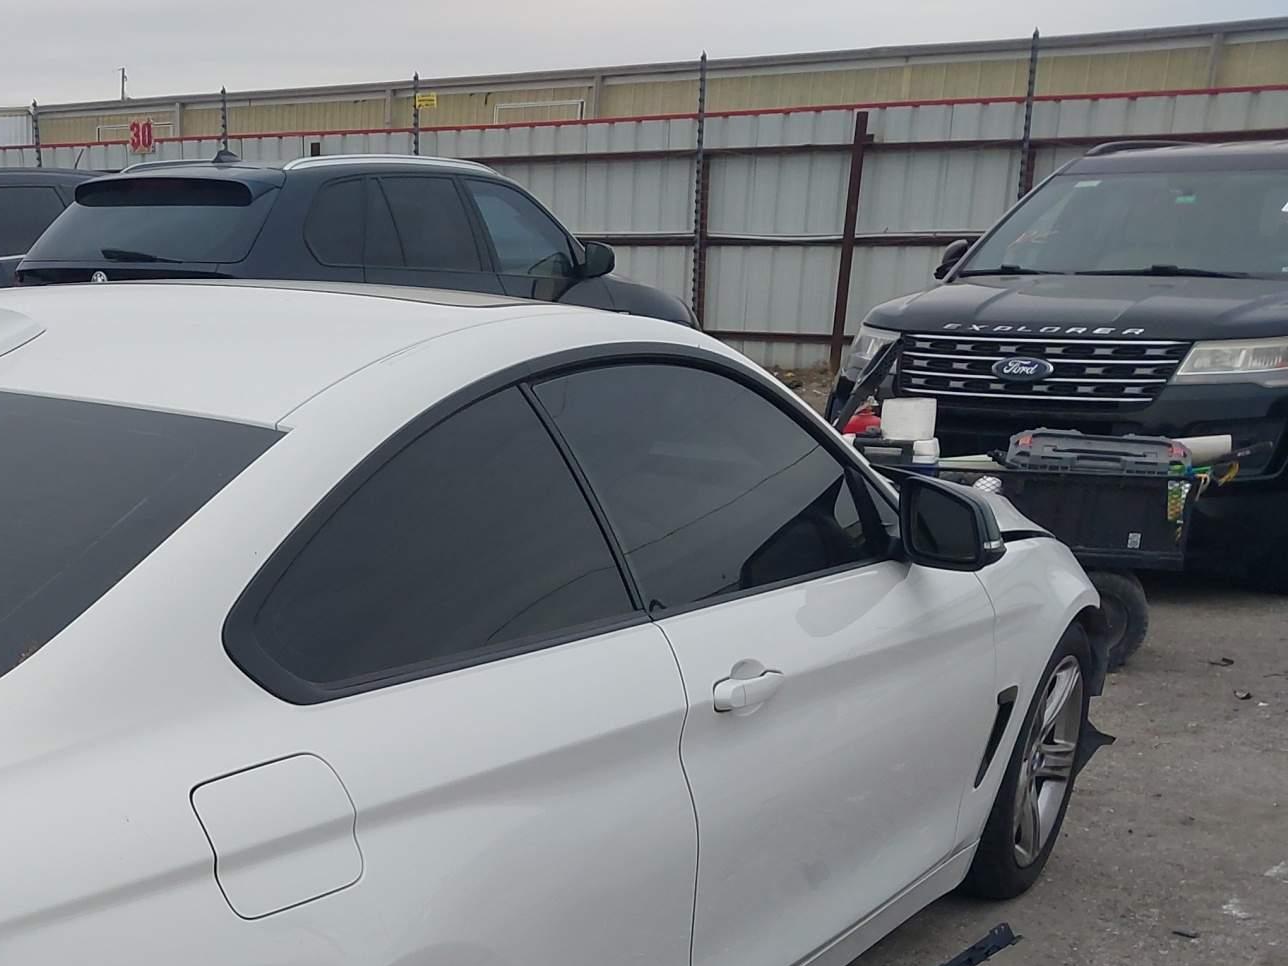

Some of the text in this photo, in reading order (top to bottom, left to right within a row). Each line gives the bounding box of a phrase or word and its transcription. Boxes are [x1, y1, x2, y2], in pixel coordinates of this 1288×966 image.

[130, 121, 152, 150] 30
[943, 322, 1145, 335] EXPLORER
[1003, 359, 1040, 375] Ford
